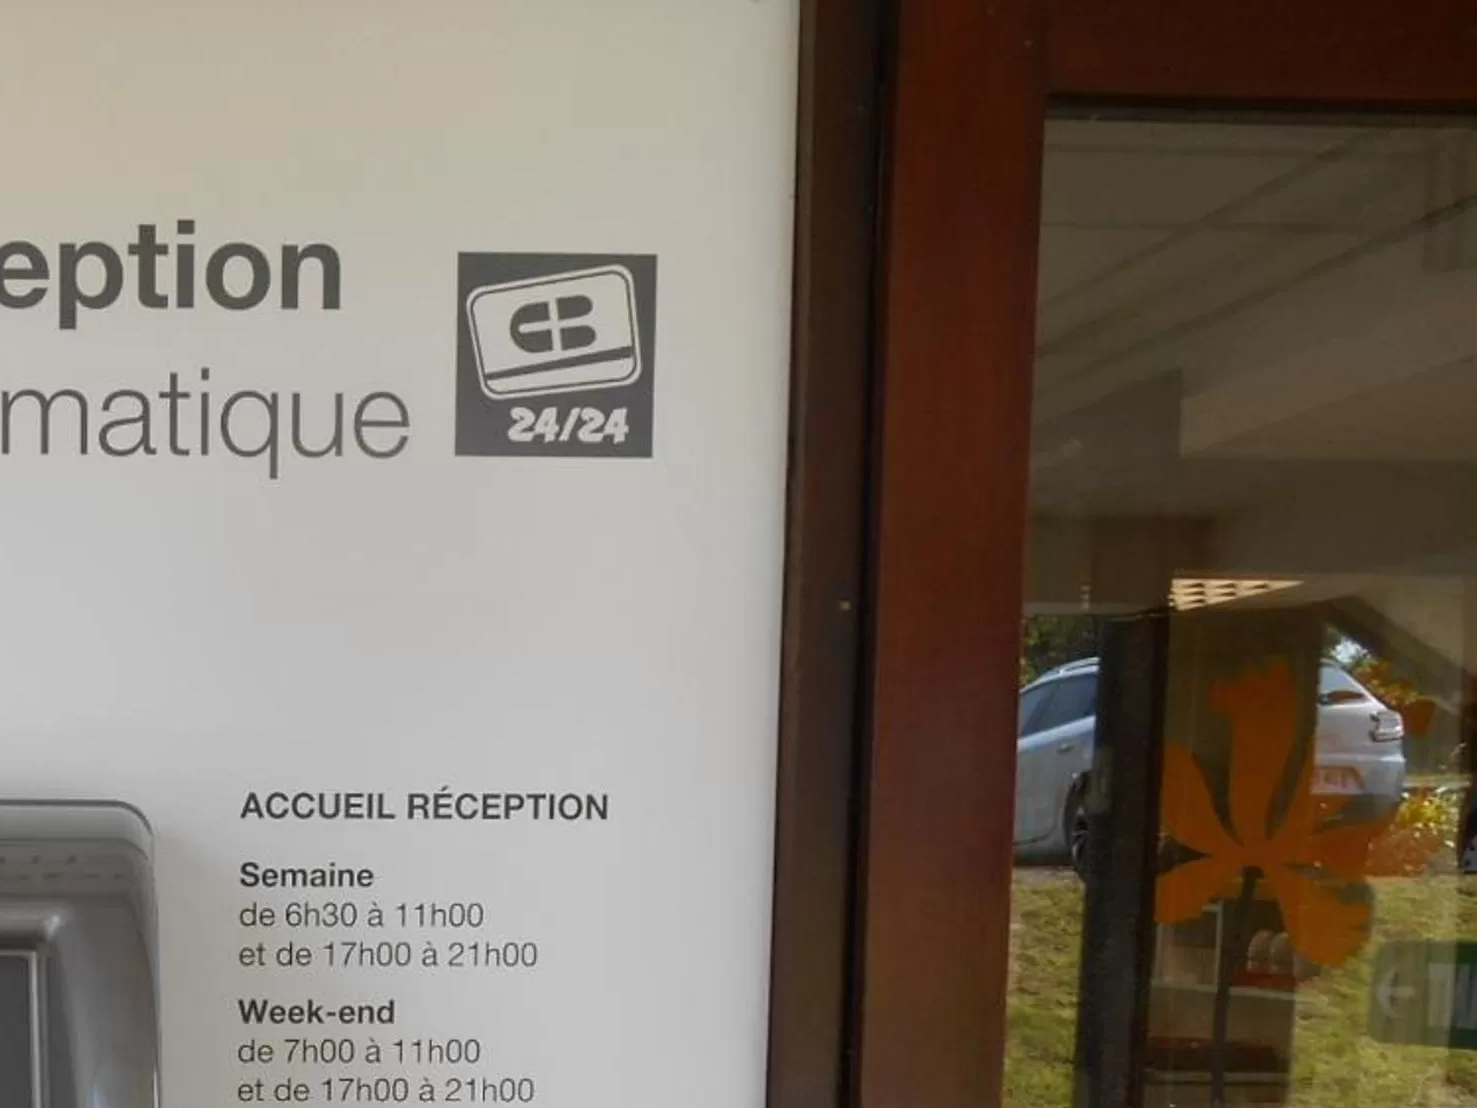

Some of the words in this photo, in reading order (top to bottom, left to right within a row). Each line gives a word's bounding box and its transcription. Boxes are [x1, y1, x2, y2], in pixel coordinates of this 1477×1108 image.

[508, 406, 629, 444] 24/24
[241, 792, 395, 819] ACCUEIL
[408, 786, 607, 820] RÉCEPTION
[240, 862, 373, 887] Semaine
[240, 902, 276, 927] de
[286, 901, 357, 927] 6h30
[368, 902, 384, 927] à
[396, 903, 483, 928] 11h00
[239, 942, 266, 967] et
[276, 941, 312, 966] de
[323, 941, 411, 966] 17h00
[422, 941, 438, 967] à
[448, 942, 537, 967] 21h00
[238, 999, 394, 1024] Week-end
[238, 1039, 274, 1063] de
[284, 1039, 355, 1063] 7h00
[365, 1038, 381, 1064] à
[393, 1039, 480, 1064] 11h00
[238, 1078, 264, 1102] et
[274, 1078, 310, 1102] de
[322, 1077, 409, 1102] 17h00
[419, 1077, 435, 1102] à
[445, 1077, 534, 1103] 21h00
